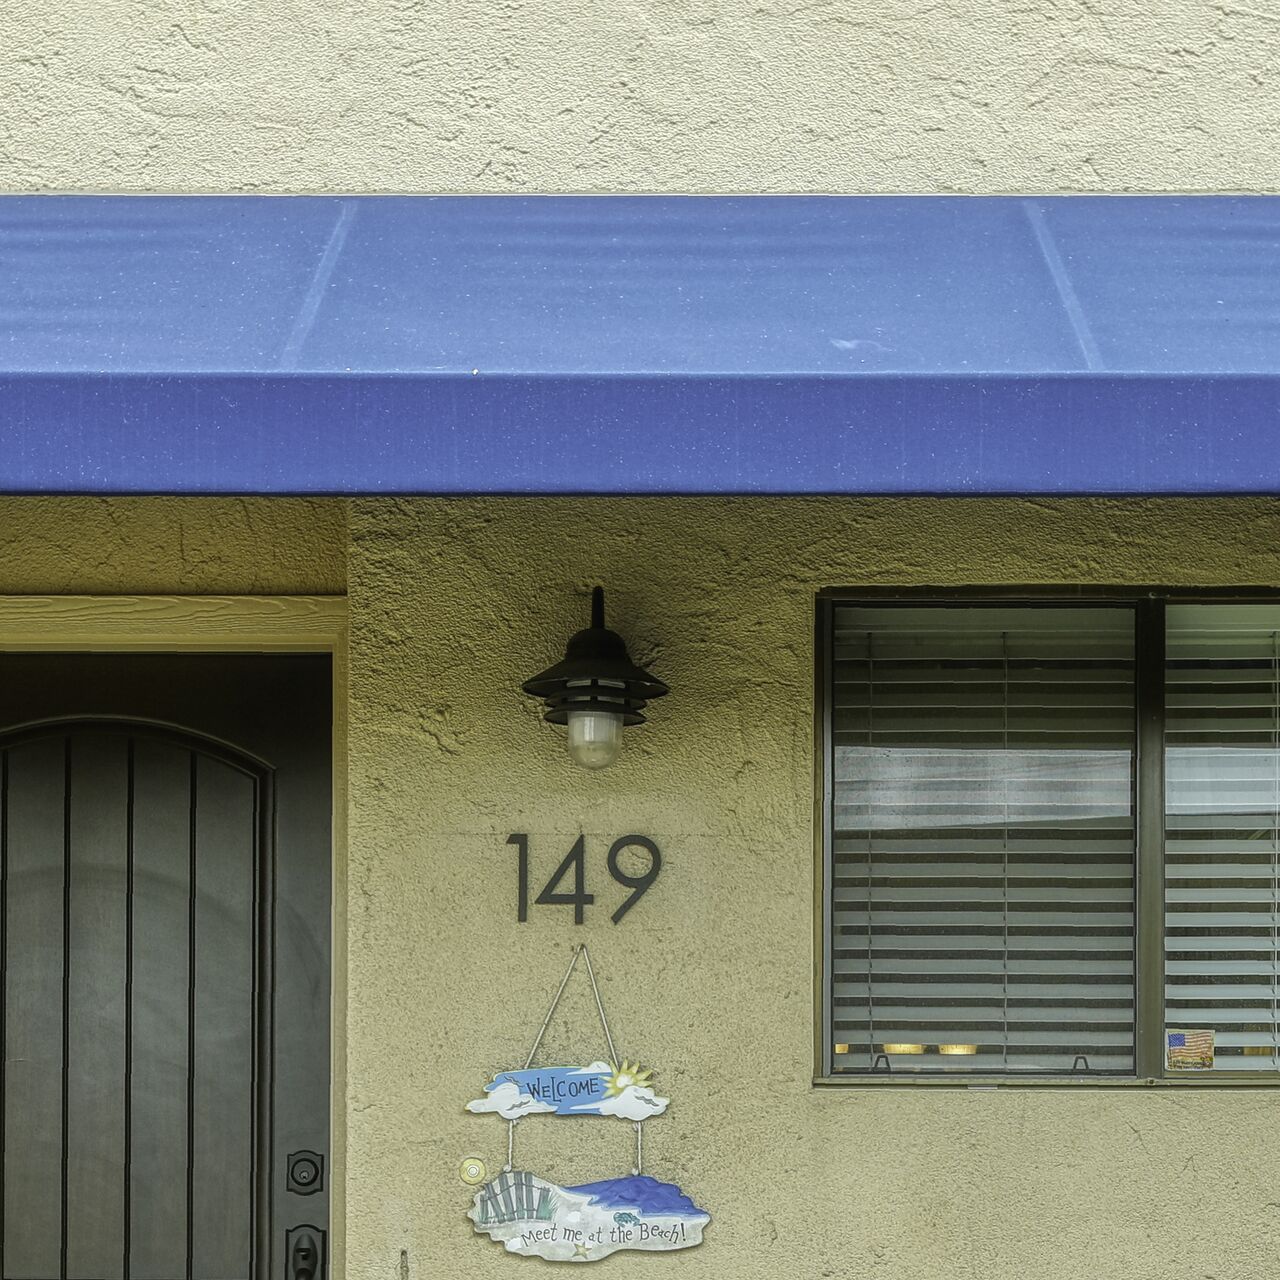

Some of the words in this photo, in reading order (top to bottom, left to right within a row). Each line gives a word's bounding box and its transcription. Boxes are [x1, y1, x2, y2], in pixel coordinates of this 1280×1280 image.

[505, 832, 662, 926] 149
[521, 1223, 558, 1247] Meet
[563, 1227, 583, 1242] me
[588, 1226, 603, 1244] at
[609, 1226, 633, 1244] the
